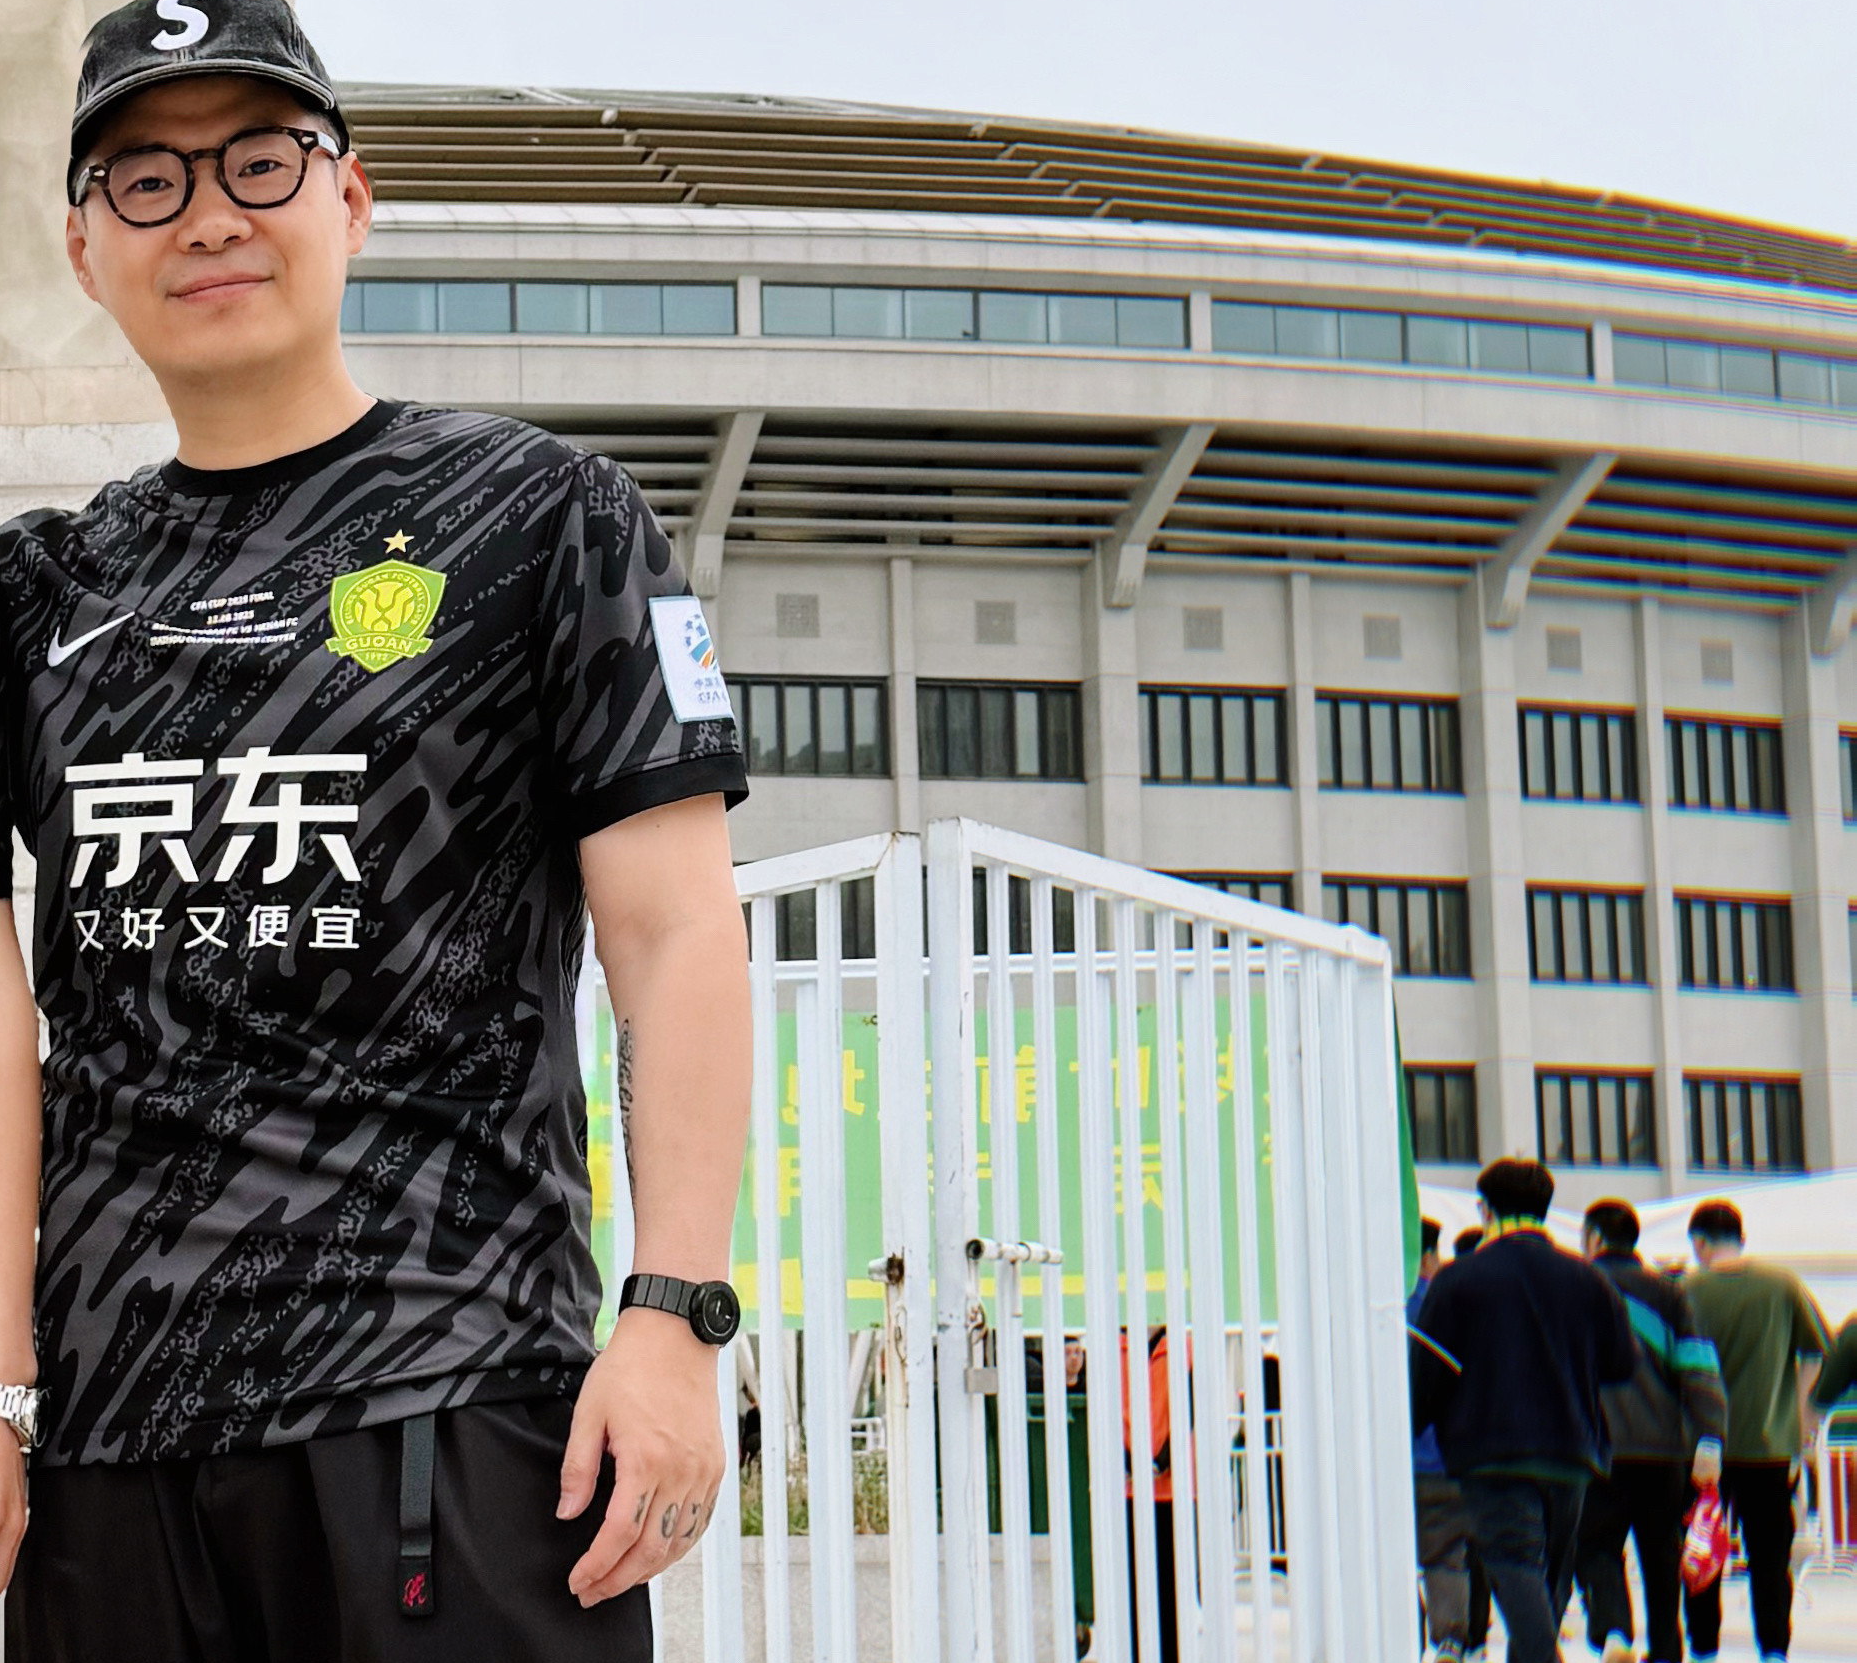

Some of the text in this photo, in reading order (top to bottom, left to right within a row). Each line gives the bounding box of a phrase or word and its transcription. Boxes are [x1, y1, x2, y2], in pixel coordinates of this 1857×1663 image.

[346, 636, 413, 653] GUOAN
[64, 745, 368, 888] 京东
[73, 904, 360, 952] 又好又便宜
